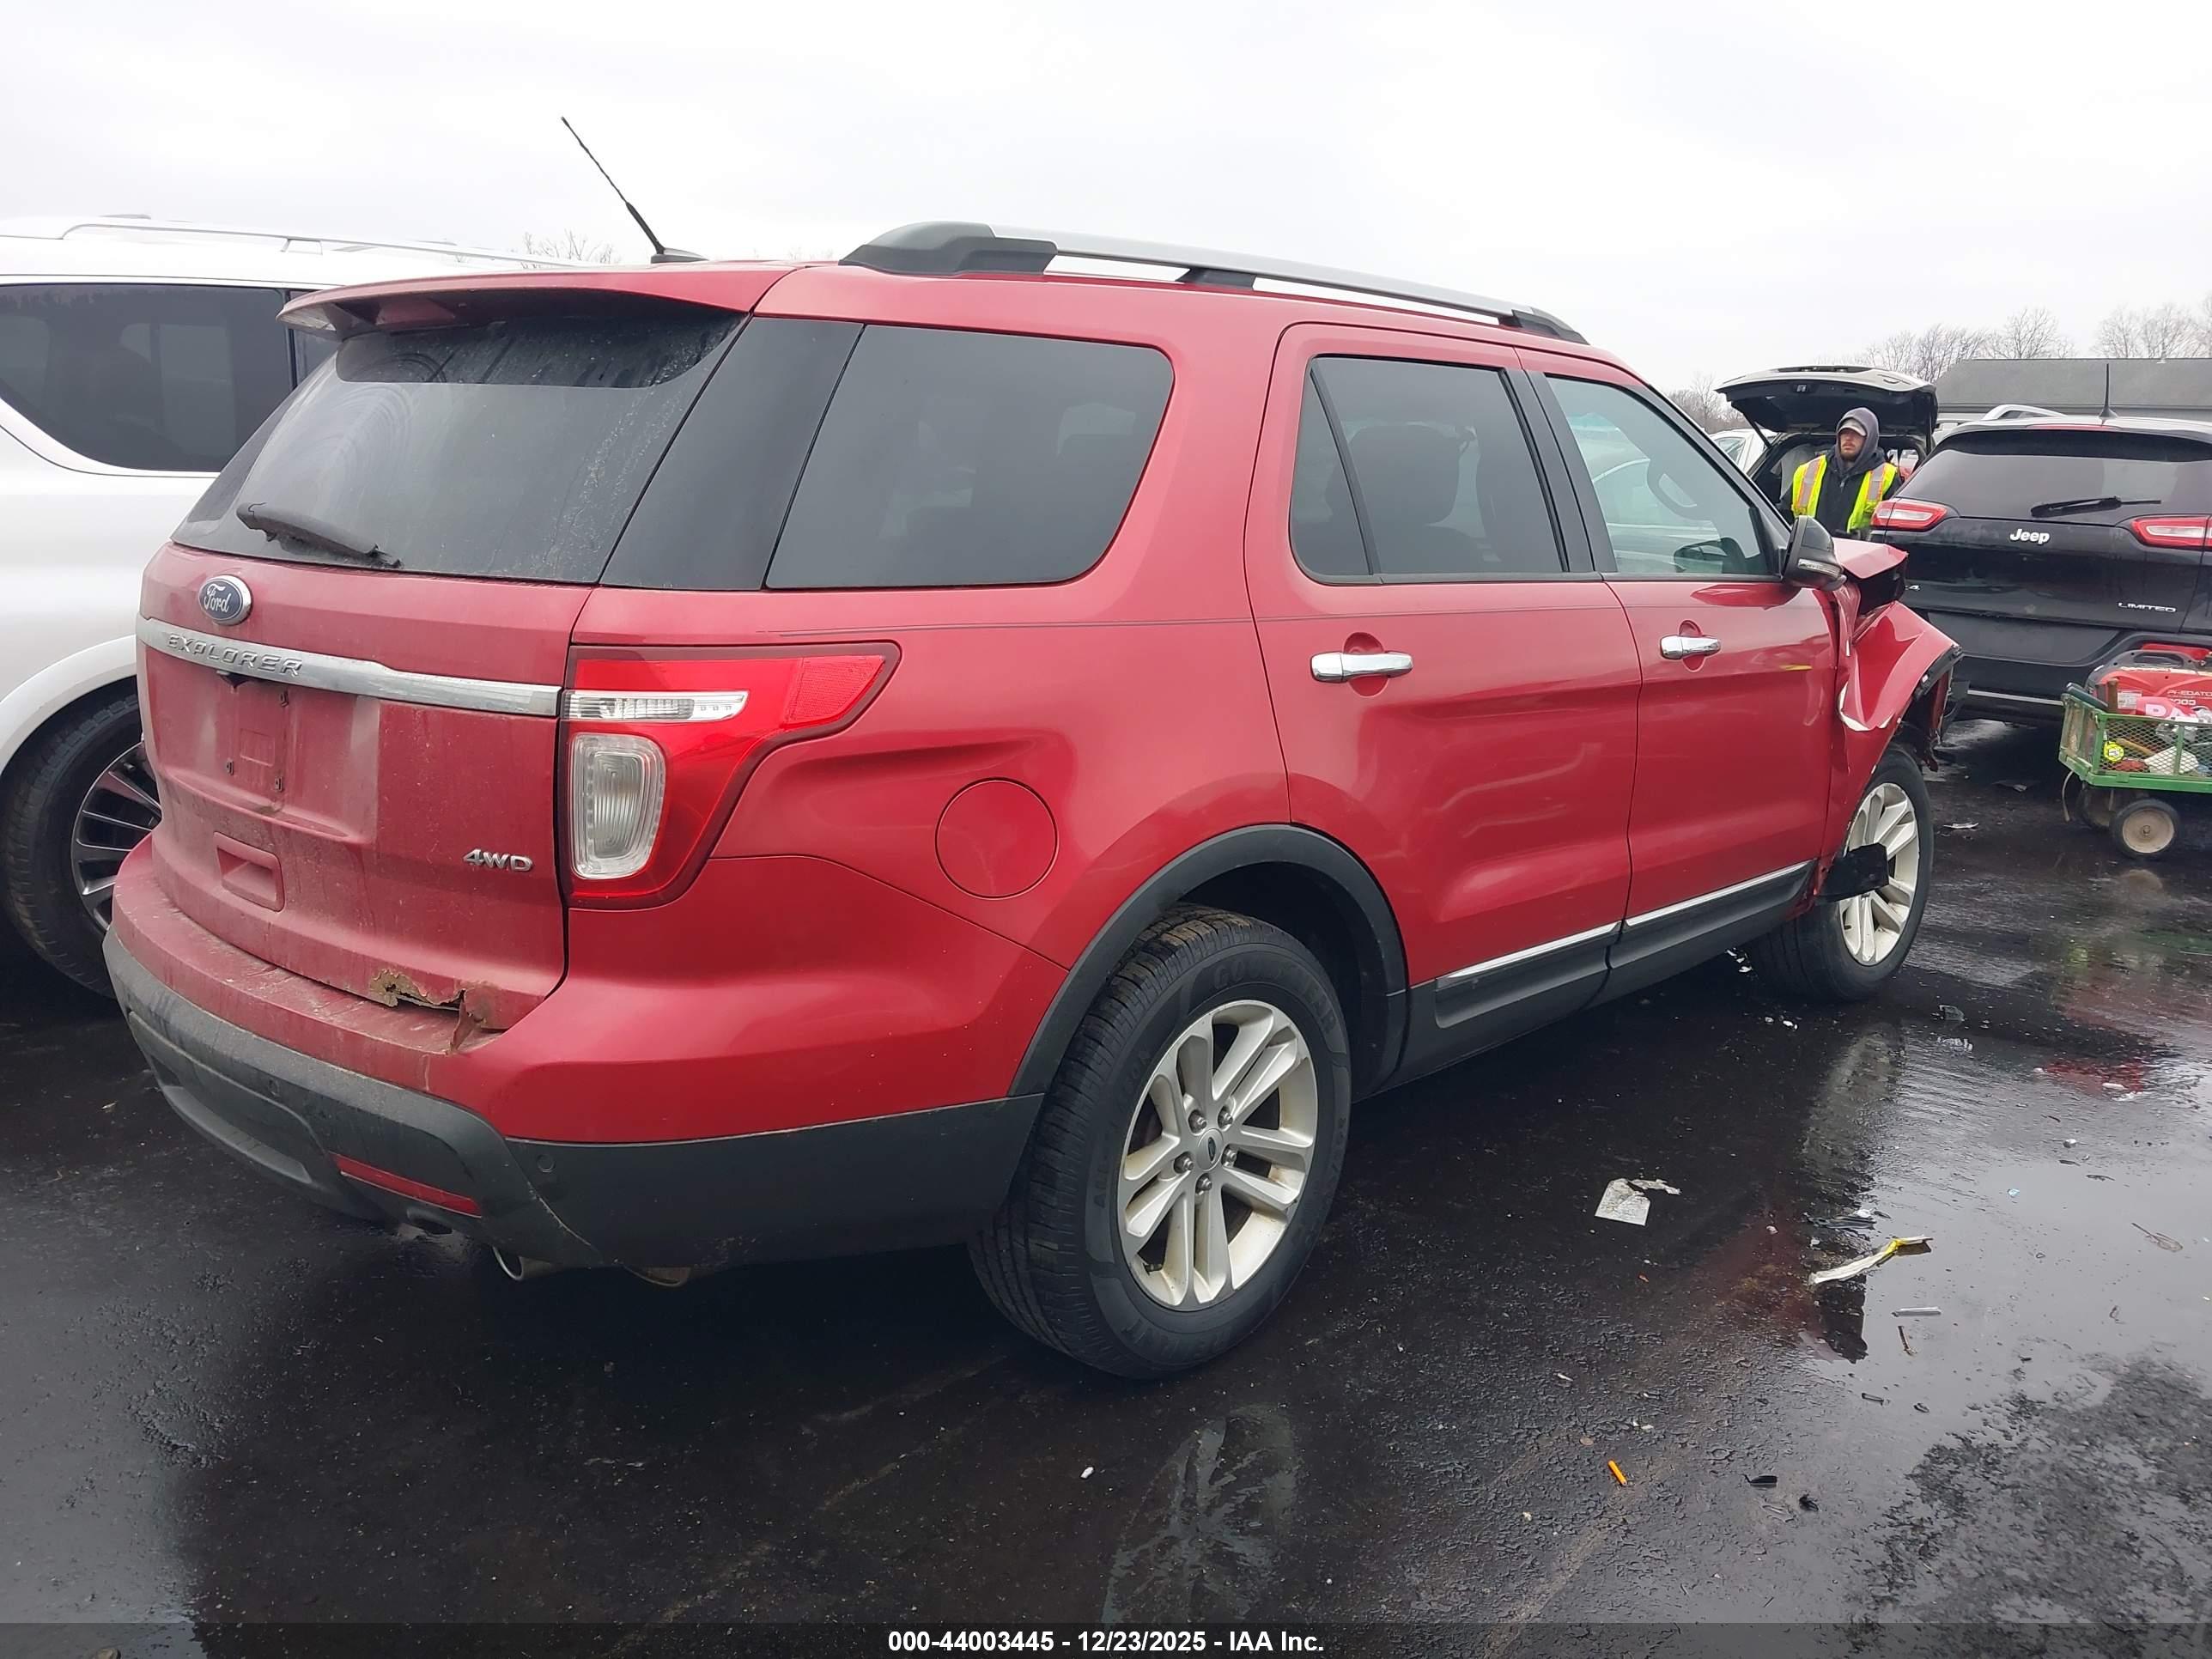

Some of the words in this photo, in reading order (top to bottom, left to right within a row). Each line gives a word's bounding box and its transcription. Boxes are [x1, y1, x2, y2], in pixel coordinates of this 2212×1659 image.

[2009, 528, 2050, 544] Jeep
[204, 583, 232, 612] Ford
[2118, 602, 2177, 612] LIMITED
[167, 632, 303, 678] EXPLORER
[463, 848, 533, 872] 4WD
